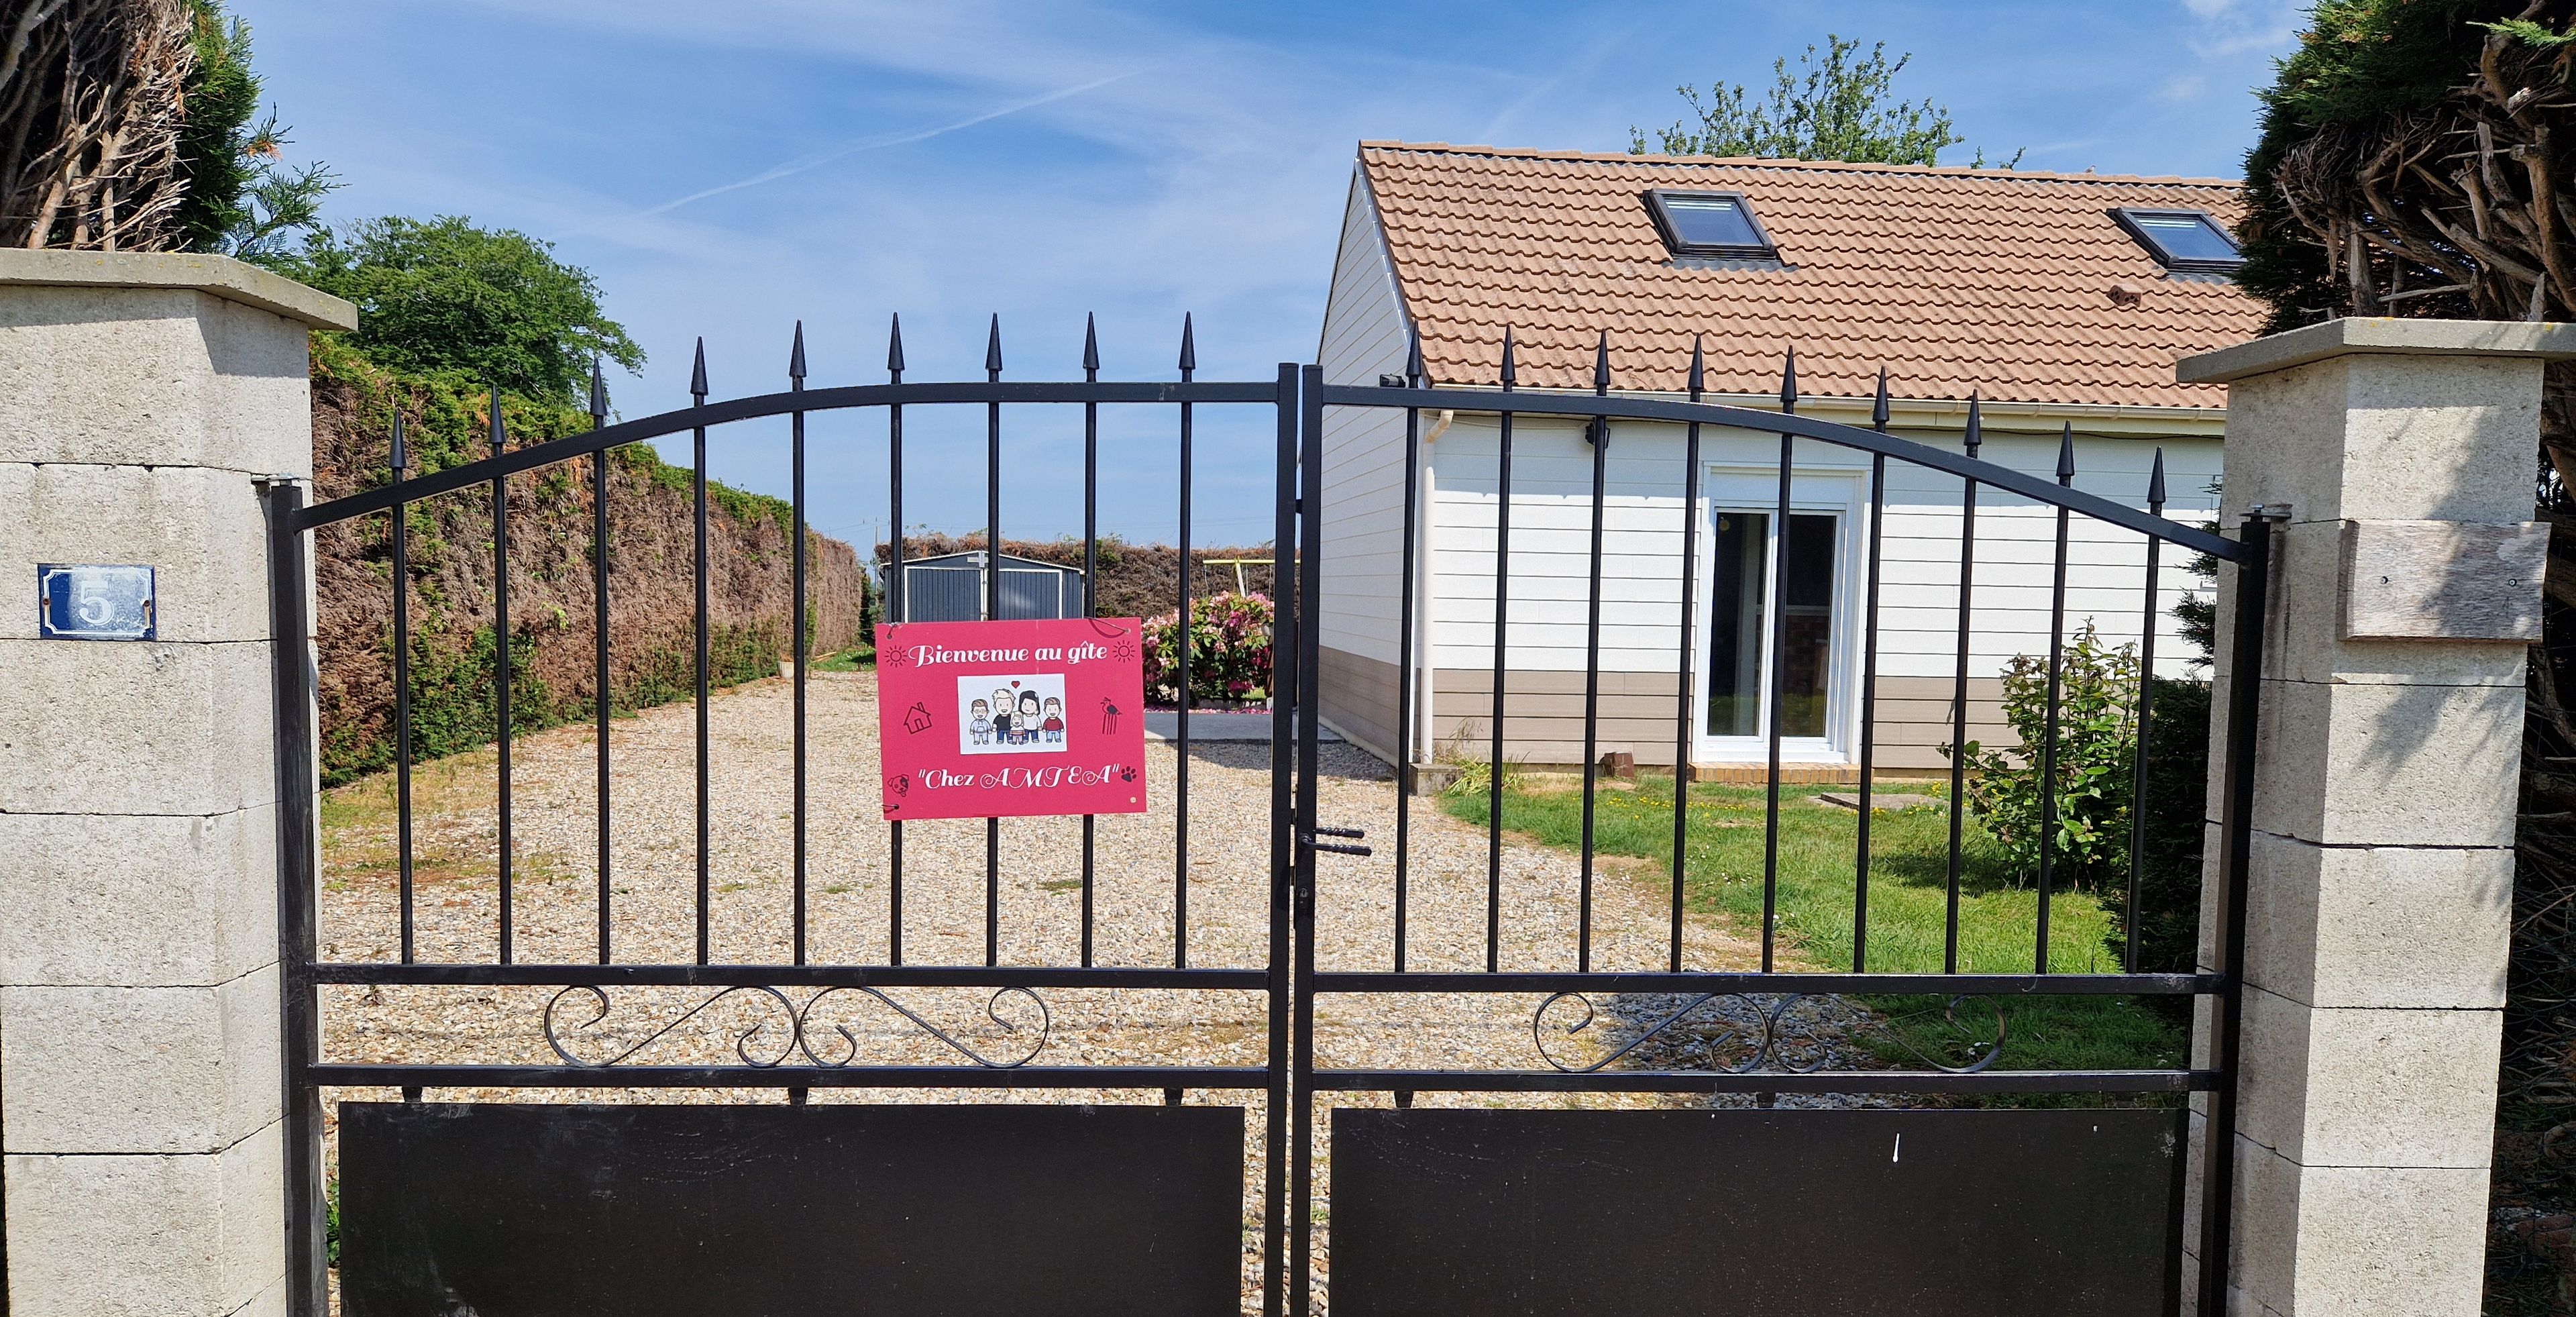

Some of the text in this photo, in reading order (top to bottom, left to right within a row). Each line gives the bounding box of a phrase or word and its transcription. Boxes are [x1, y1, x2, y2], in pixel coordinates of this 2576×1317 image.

[79, 579, 115, 625] 5
[908, 641, 1108, 668] Bienvenue au gîte
